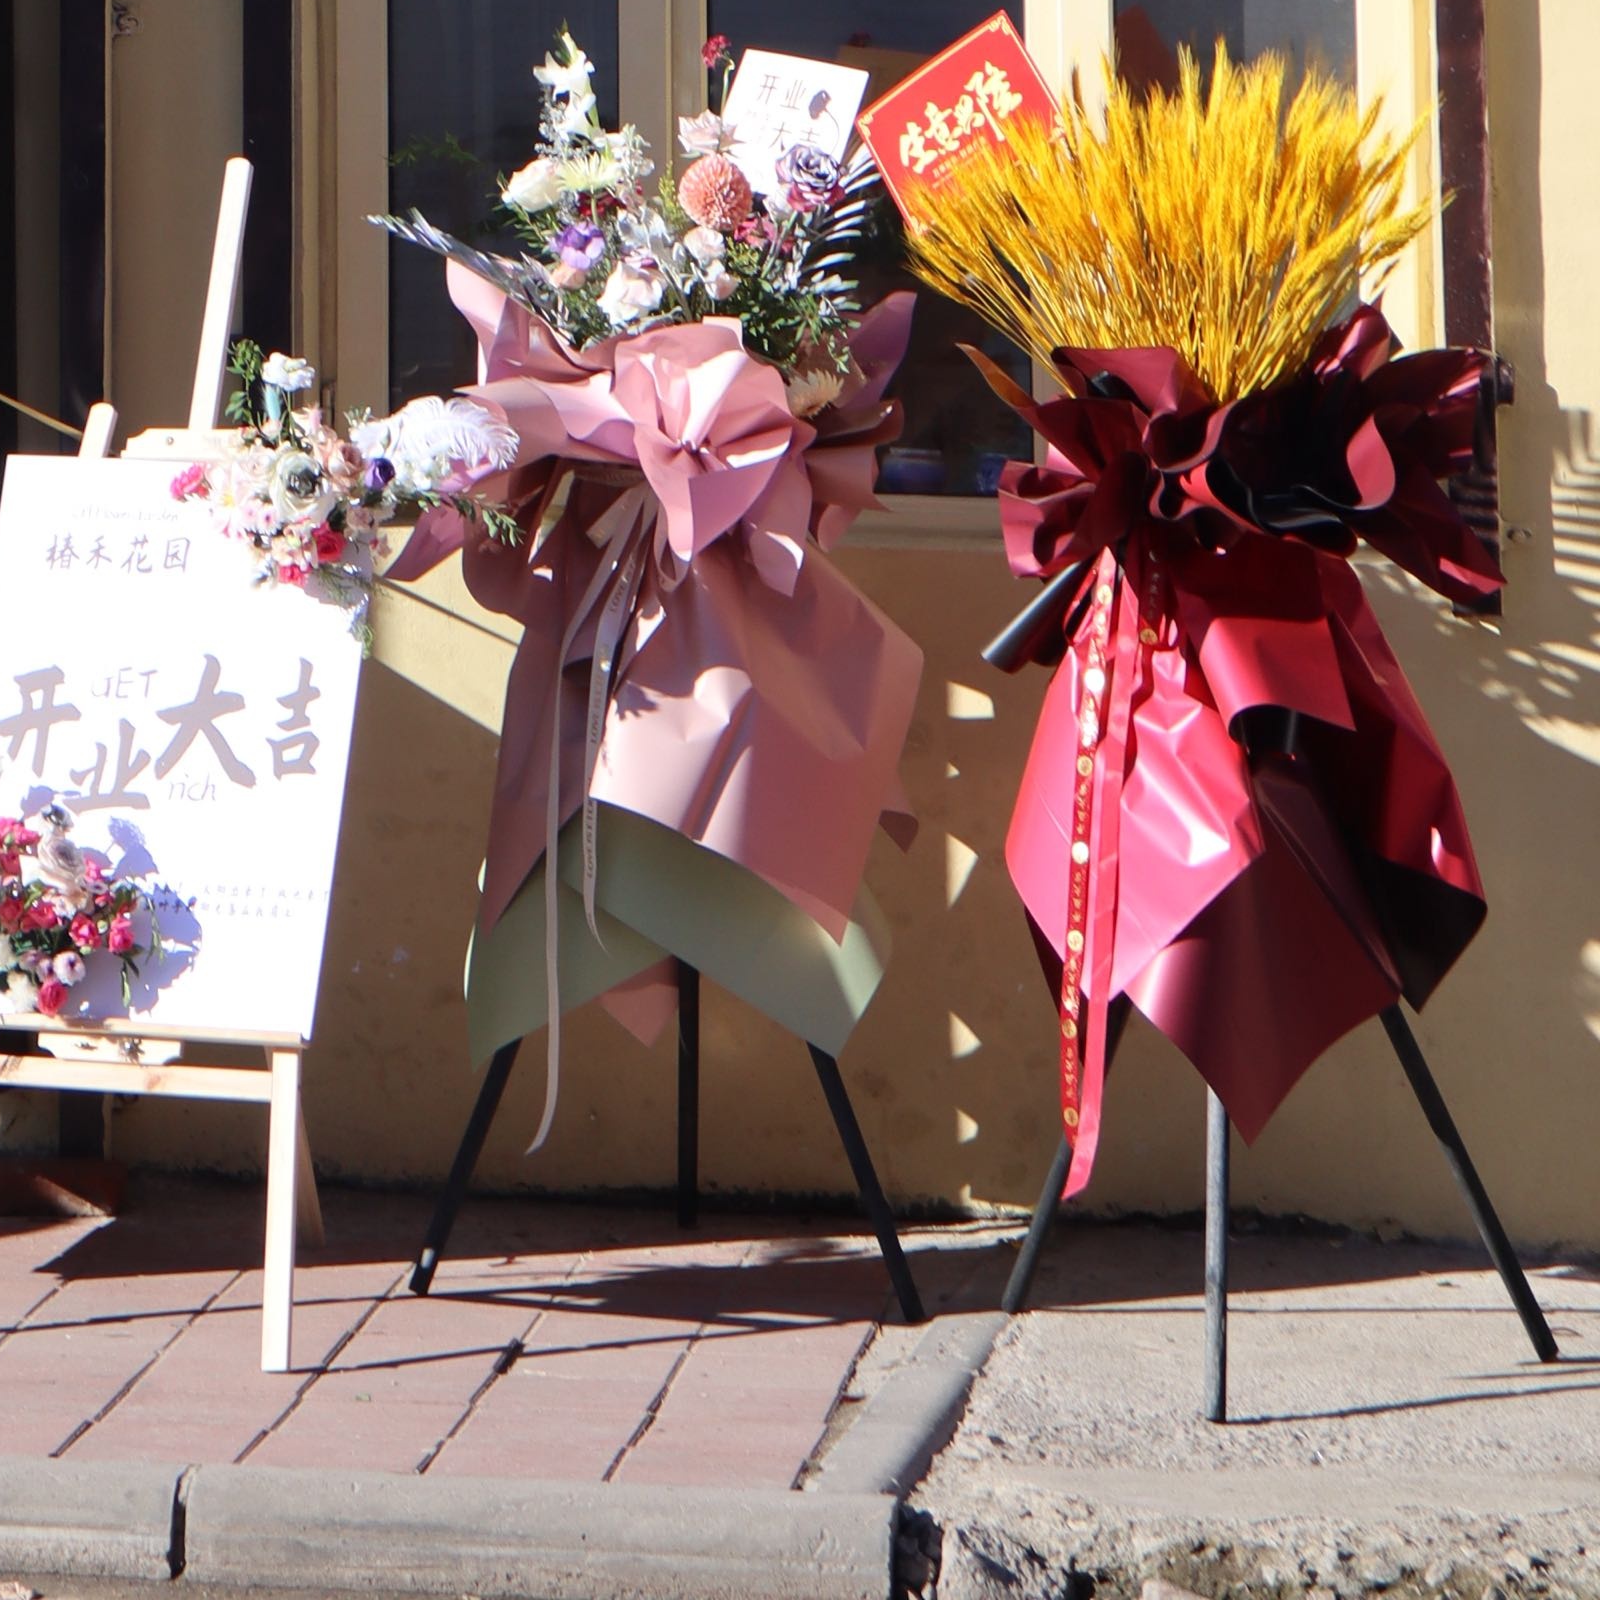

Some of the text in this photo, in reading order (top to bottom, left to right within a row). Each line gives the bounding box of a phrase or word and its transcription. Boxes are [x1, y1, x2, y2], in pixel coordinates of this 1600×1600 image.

[757, 74, 807, 110] 开业
[45, 533, 191, 574] 椿禾花园
